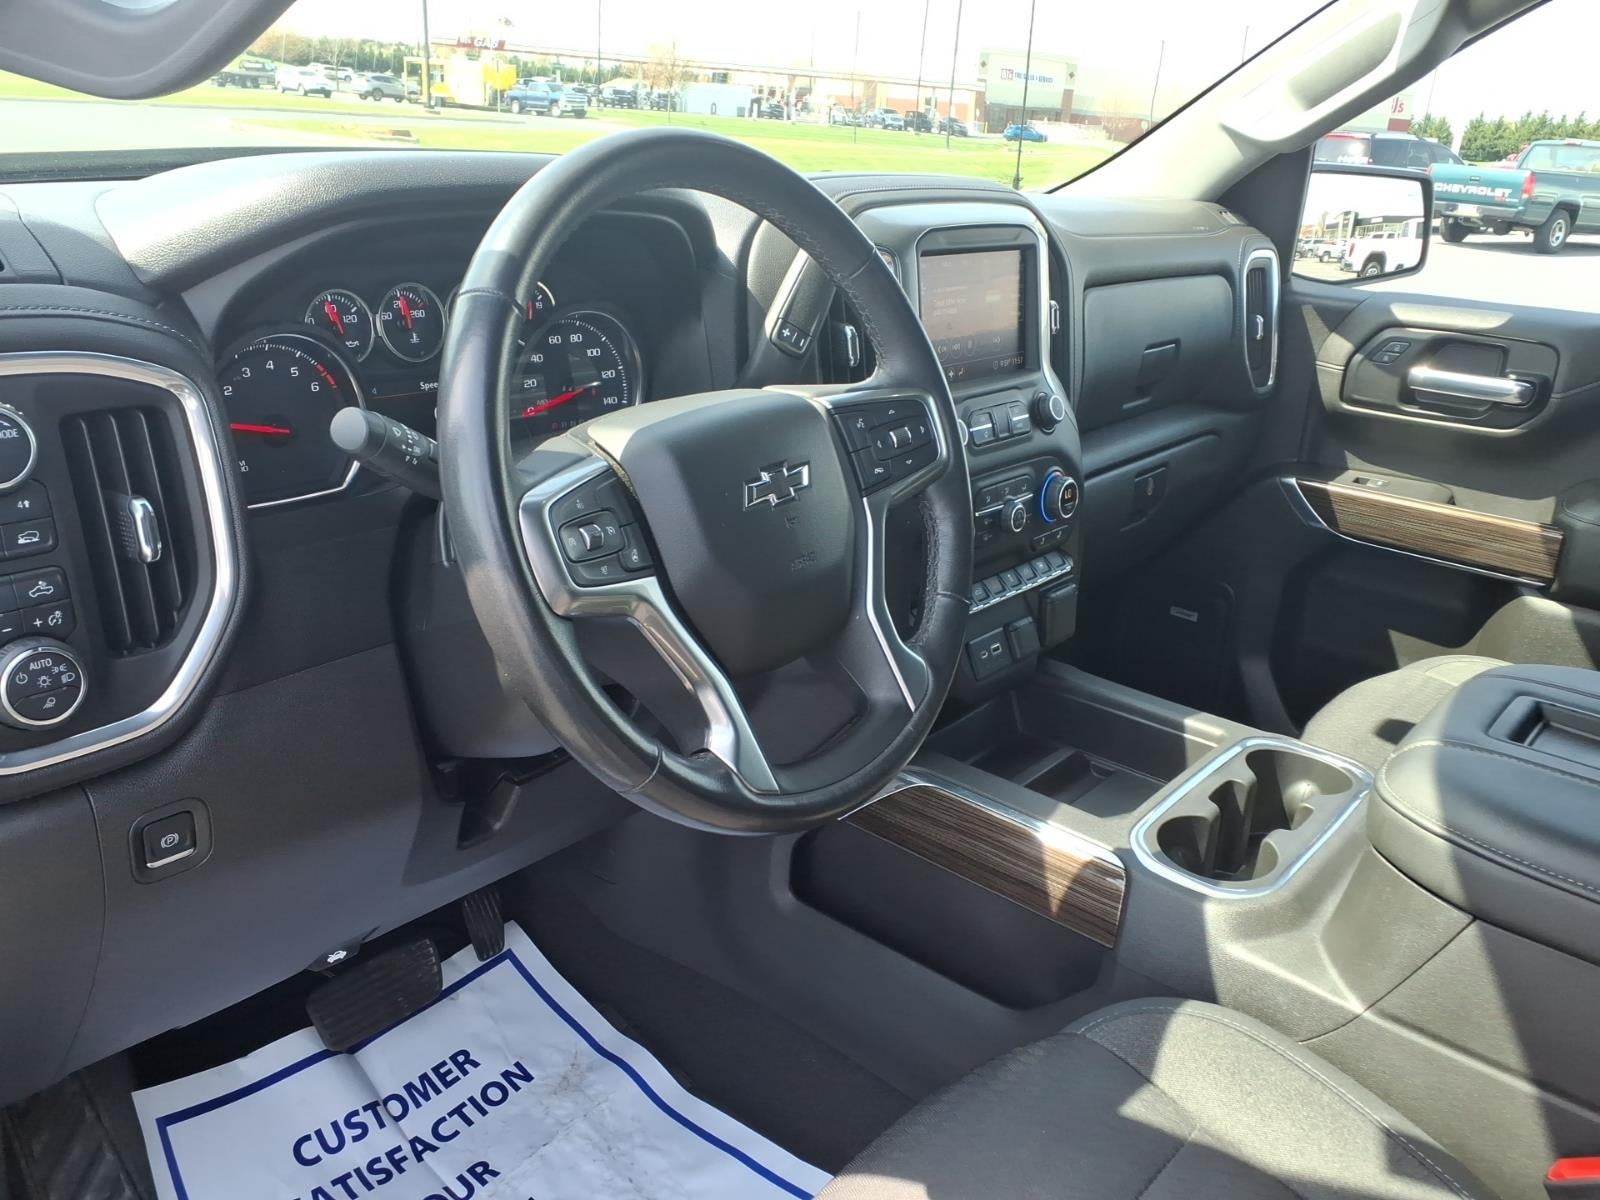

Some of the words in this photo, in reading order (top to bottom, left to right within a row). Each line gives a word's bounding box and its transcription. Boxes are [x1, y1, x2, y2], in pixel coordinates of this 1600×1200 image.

[1433, 182, 1512, 198] CHEVROLET
[343, 314, 358, 323] 120
[410, 309, 426, 319] 260
[548, 335, 562, 345] 60
[570, 333, 583, 343] 80
[530, 353, 544, 363] 40
[586, 348, 601, 358] 100
[265, 360, 275, 370] 4
[241, 367, 252, 378] 3
[290, 366, 300, 377] 5
[601, 369, 616, 379] 120
[310, 381, 320, 392] 6
[523, 378, 537, 388] 20
[223, 385, 233, 396] 2
[603, 396, 618, 406] 140
[29, 657, 53, 671] AUTO
[292, 1049, 481, 1167] CUSTOMER
[293, 1061, 535, 1200] ATISFACTION
